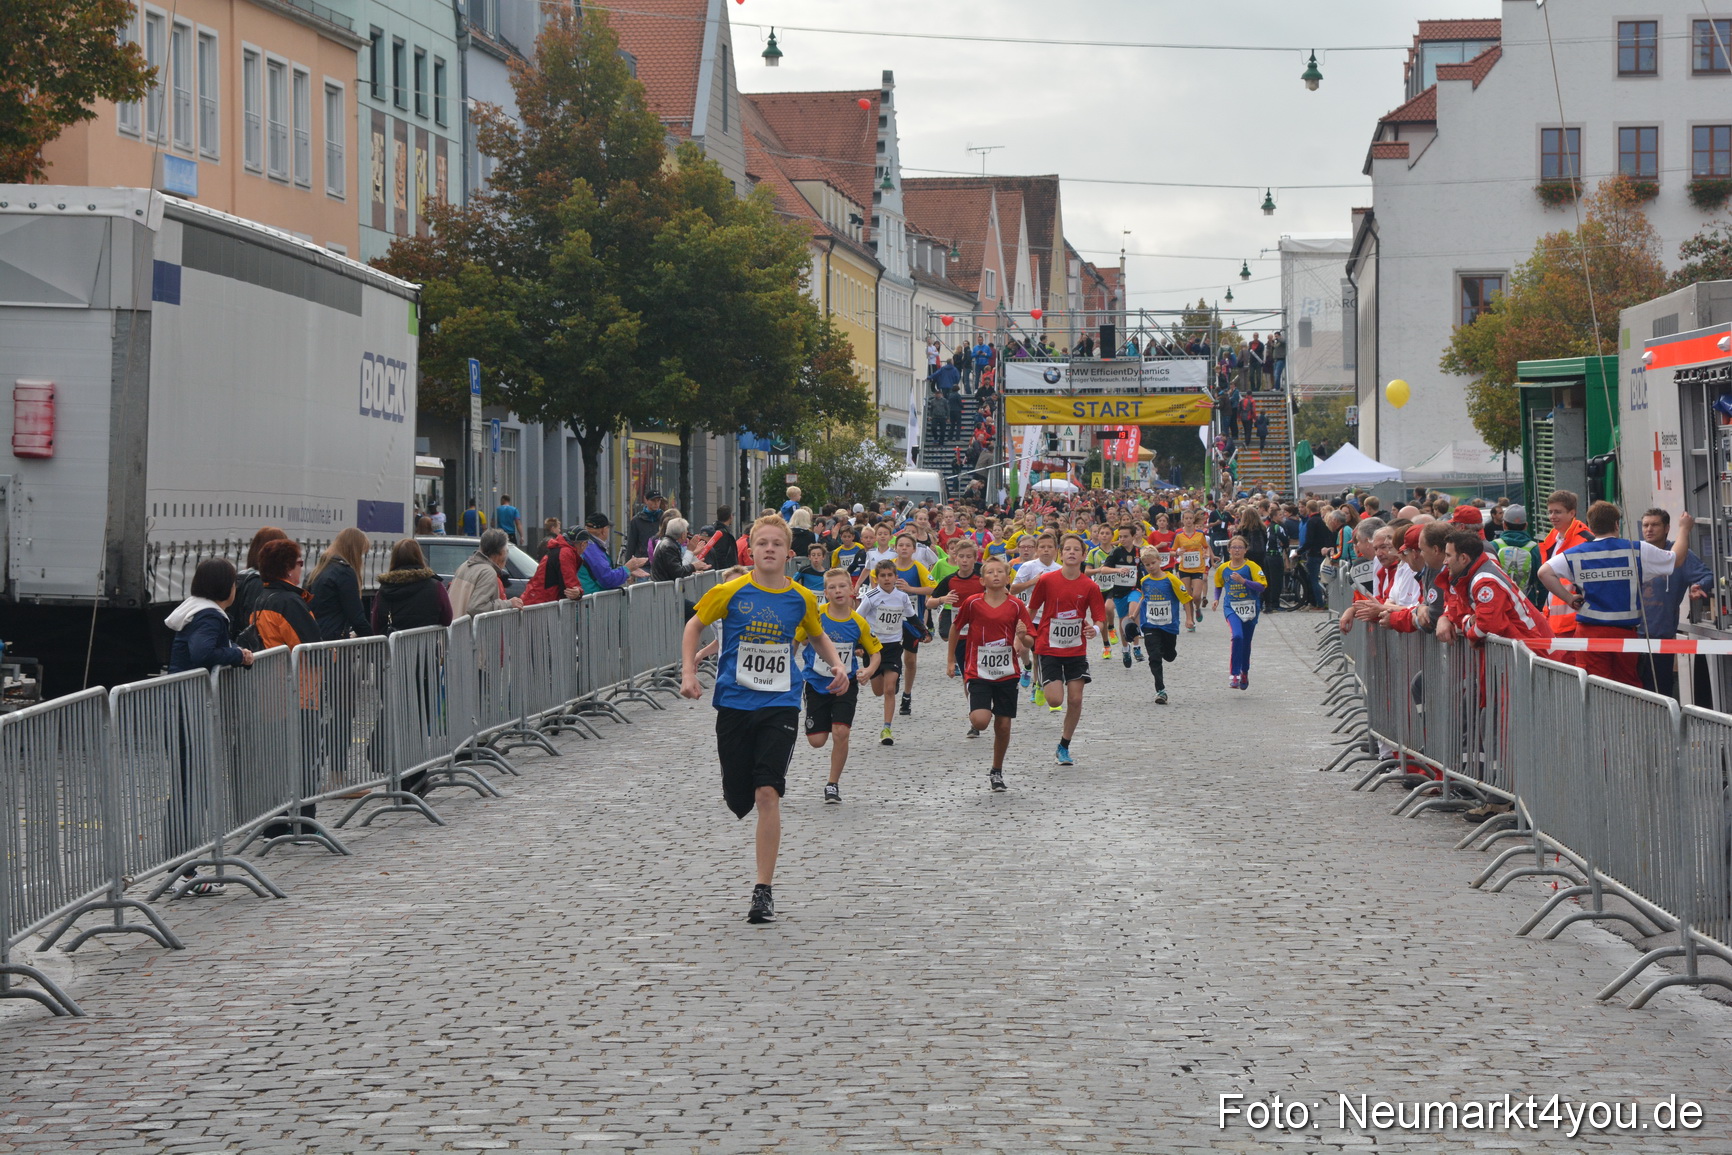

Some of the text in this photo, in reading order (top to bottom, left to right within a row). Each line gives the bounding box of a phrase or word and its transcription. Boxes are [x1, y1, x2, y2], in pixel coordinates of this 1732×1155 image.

[472, 363, 478, 389] P
[360, 352, 407, 422] BOCK
[1073, 401, 1143, 418] START
[1094, 477, 1100, 485] A
[1579, 569, 1633, 580] SEG-LEITER
[1149, 607, 1169, 616] 4041
[1235, 606, 1254, 615] 4024
[879, 612, 902, 624] 4037
[1053, 625, 1080, 637] 4000
[740, 645, 757, 653] PARTL
[742, 654, 786, 673] 4046
[981, 653, 1010, 668] 4028
[753, 676, 773, 685] David
